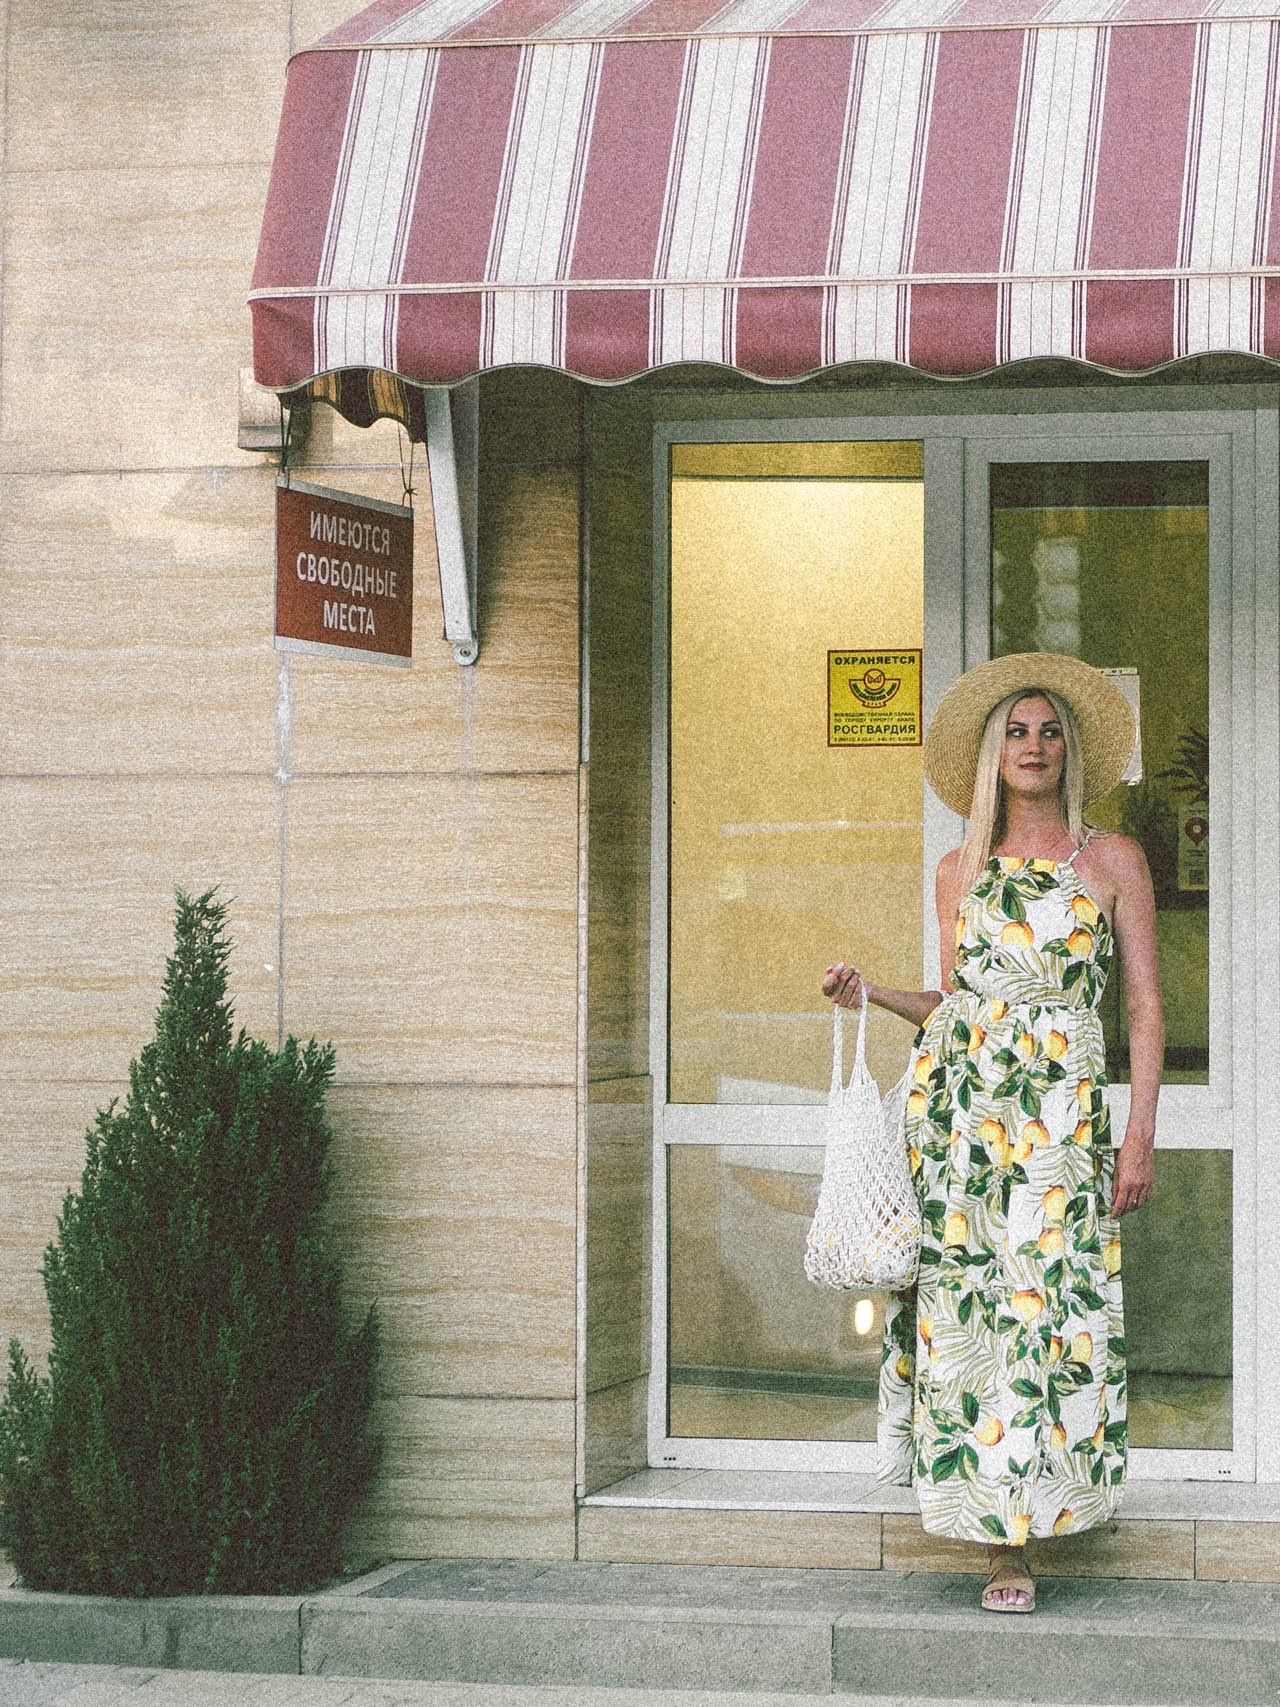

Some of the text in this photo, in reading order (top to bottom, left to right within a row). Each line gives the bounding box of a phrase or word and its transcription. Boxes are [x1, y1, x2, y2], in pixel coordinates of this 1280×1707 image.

[310, 511, 390, 555] ИМЕЮТСЯ
[296, 551, 397, 598] СВОБОДНЫЕ
[323, 600, 376, 636] МЕСТА
[835, 656, 915, 665] ОХРАНЯЕТСЯ
[834, 724, 916, 735] РОСГВАРДИЯ
